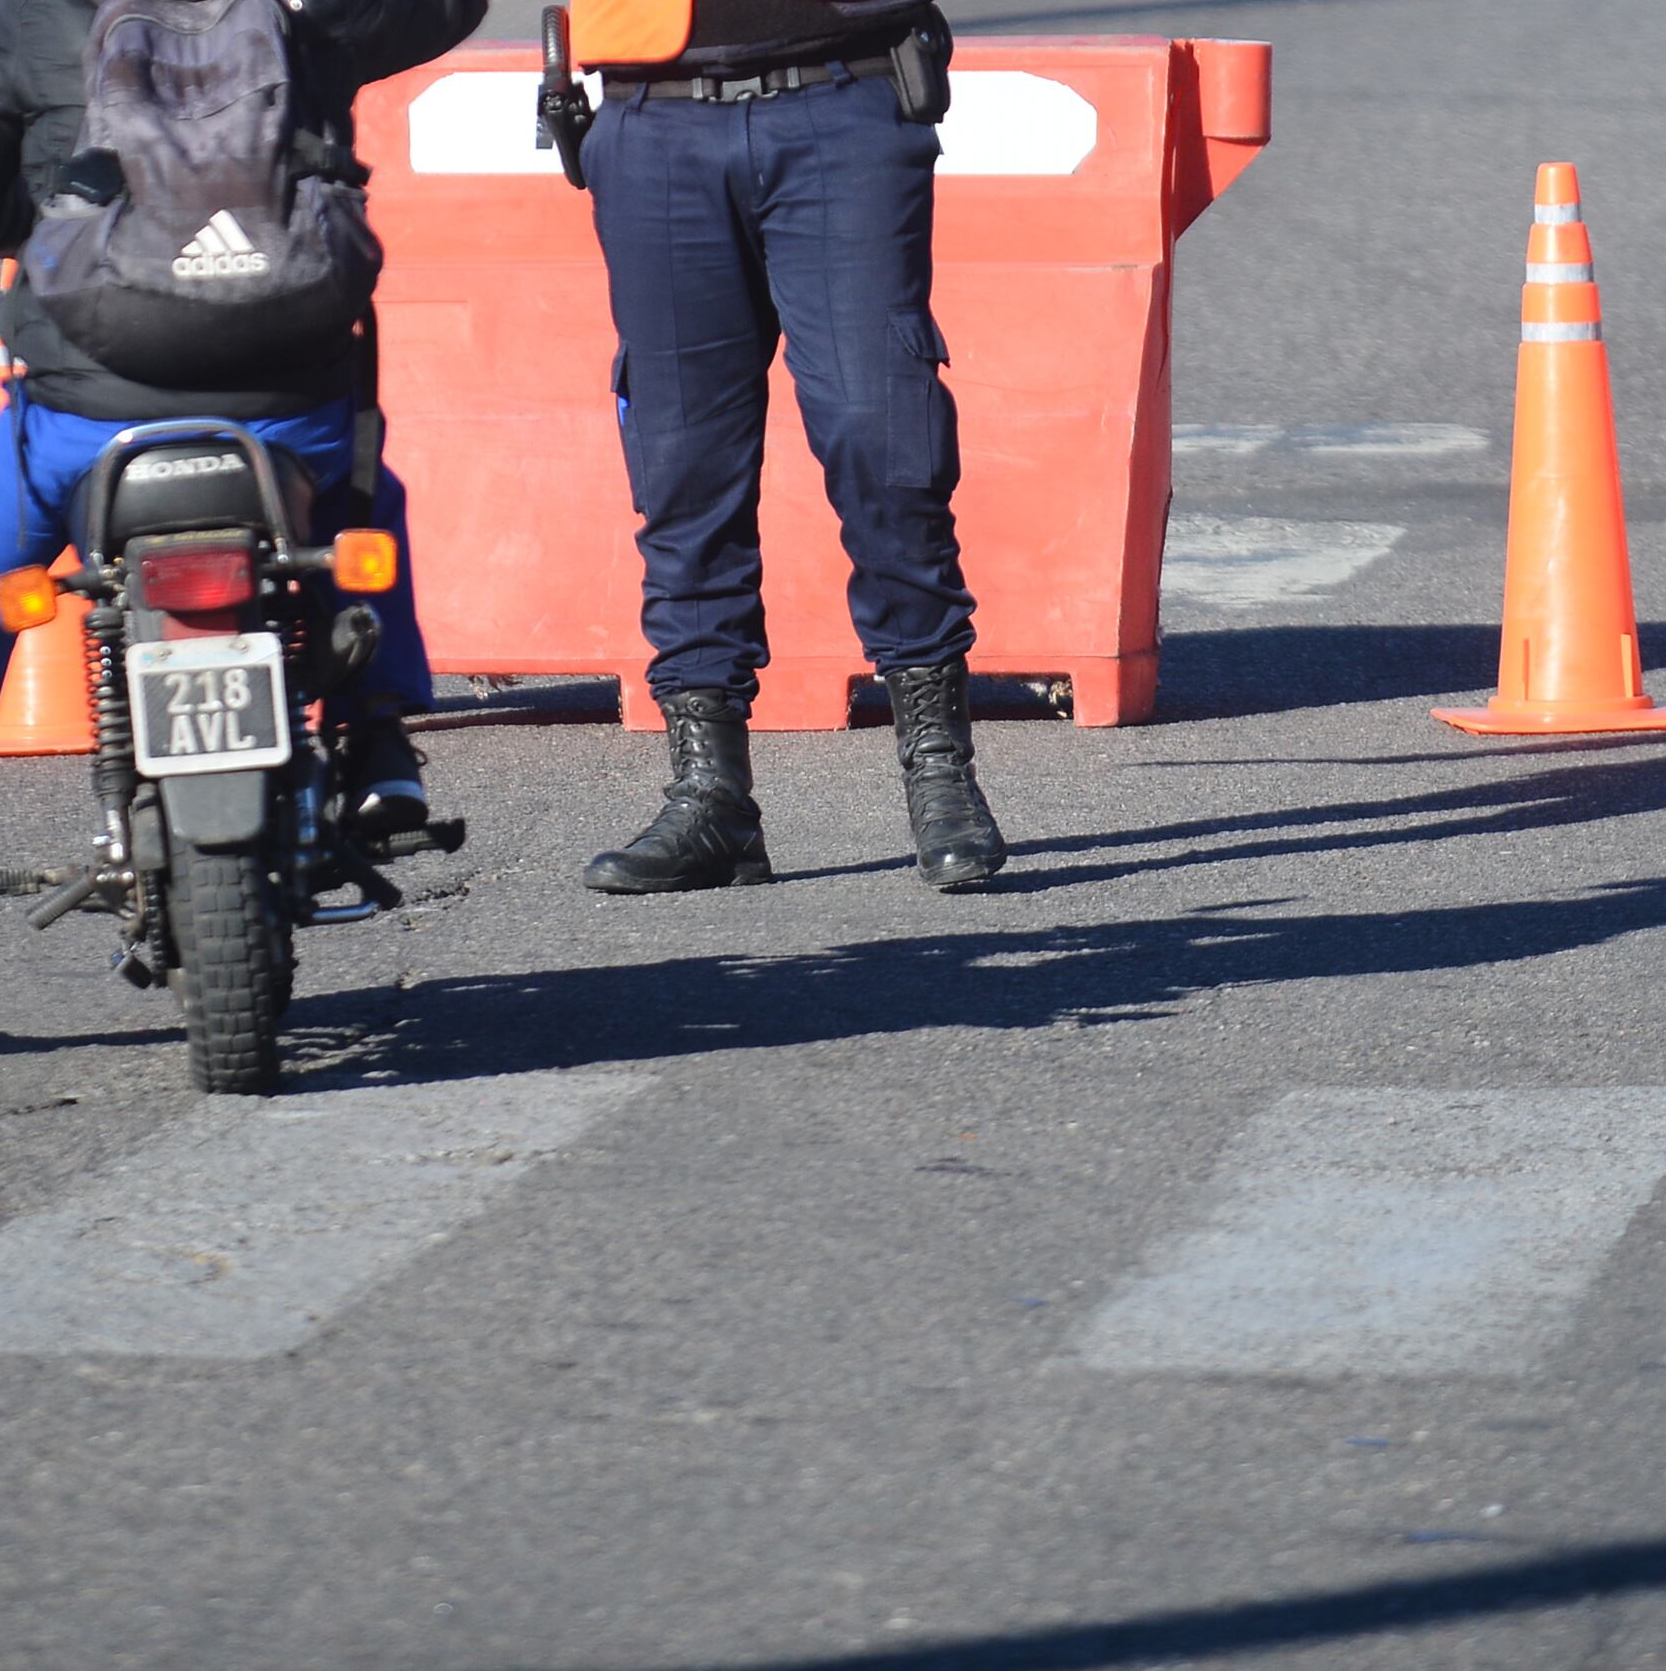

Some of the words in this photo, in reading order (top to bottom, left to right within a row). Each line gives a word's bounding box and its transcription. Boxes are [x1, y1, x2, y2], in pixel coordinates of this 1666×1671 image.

[171, 250, 270, 281] adidas
[123, 452, 247, 481] HONDA
[164, 667, 252, 715] 218
[167, 710, 257, 755] AVL
